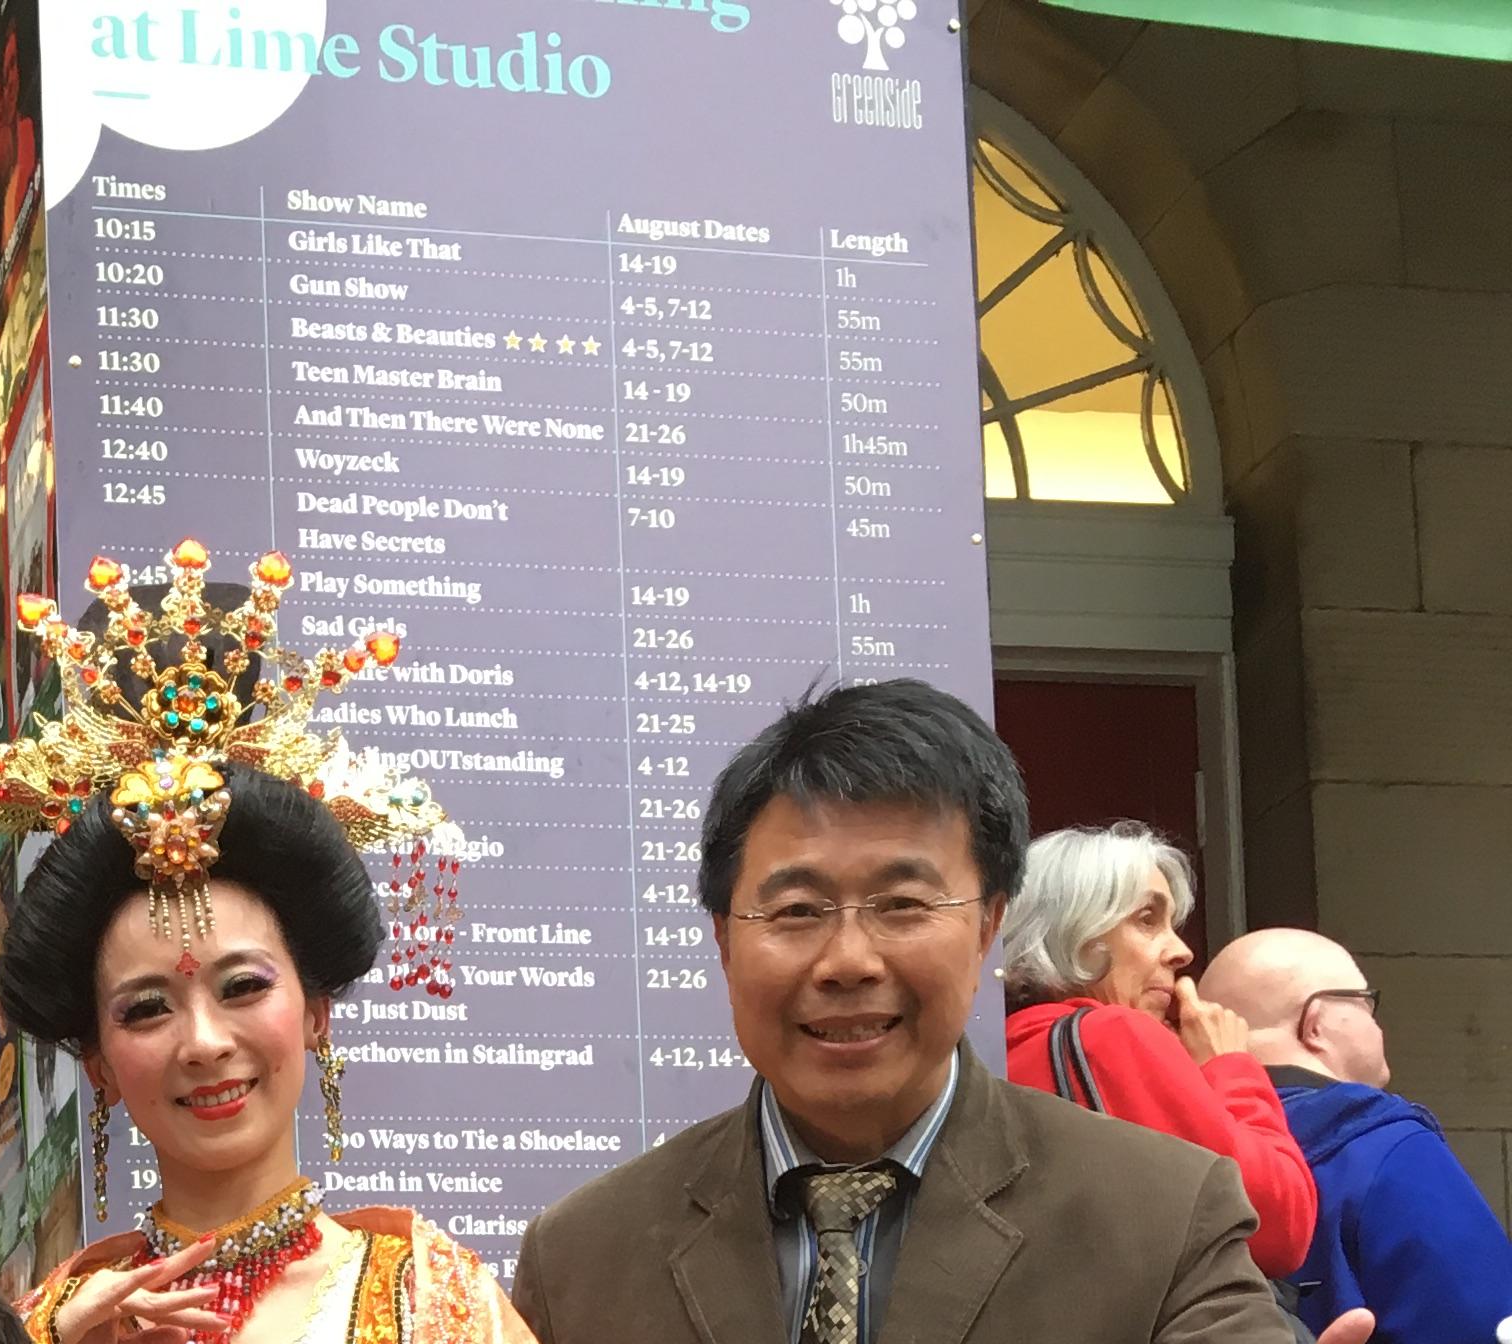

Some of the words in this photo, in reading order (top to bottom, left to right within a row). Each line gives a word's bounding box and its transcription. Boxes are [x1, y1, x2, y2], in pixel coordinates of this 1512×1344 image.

[91, 12, 160, 62] at
[178, 6, 361, 80] Lime
[378, 22, 612, 99] Studio
[92, 174, 166, 202] Times
[287, 188, 353, 214] Show
[357, 194, 429, 220] Name
[93, 216, 157, 242] 10:15
[617, 212, 701, 242] August
[704, 219, 771, 244] Dates
[287, 229, 349, 255] Girls
[352, 232, 403, 259] Like
[406, 236, 463, 262] That
[830, 228, 909, 257] Length
[94, 261, 165, 286] 10:20
[618, 252, 677, 276] 14-19
[289, 273, 342, 298] Gun
[345, 275, 409, 302] Show
[835, 267, 857, 289] 1h
[96, 305, 160, 331] 11:30
[668, 298, 713, 321] 7-12
[836, 308, 882, 332] 55m
[290, 317, 368, 344] Beasts
[370, 320, 393, 345] &
[395, 321, 497, 351] Beauties
[97, 350, 162, 375] 11:30
[669, 340, 714, 364] 7-12
[838, 350, 884, 373] 55m
[291, 360, 350, 386] Teen
[352, 363, 435, 392] Master
[437, 366, 503, 394] Brain
[98, 393, 165, 419] 11:40
[840, 392, 889, 415] 50m
[293, 403, 343, 429] And
[345, 406, 407, 432] Then
[409, 408, 479, 436] There
[481, 413, 542, 439] Were
[544, 416, 606, 443] None
[624, 423, 687, 446] 21-26
[100, 437, 169, 463] 12:40
[841, 433, 909, 457] 1h45m
[294, 446, 400, 478] Woyzeck
[625, 464, 686, 487] 14-19
[843, 476, 892, 498] 50m
[102, 481, 167, 507] 12:45
[296, 491, 358, 517] Dead
[361, 493, 441, 525] People
[627, 507, 676, 530] 7-10
[845, 517, 891, 540] 45m
[298, 527, 357, 553] Have
[359, 530, 446, 556] Secrets
[299, 571, 351, 599] Play
[353, 574, 482, 605] Something
[630, 585, 690, 608] 14-19
[849, 593, 871, 615] 1h
[301, 614, 345, 637] Sad
[347, 616, 408, 639] Girls
[632, 627, 695, 650] 21-26
[850, 635, 896, 657] 55m
[391, 660, 446, 684] with
[448, 663, 515, 688] Doris
[633, 671, 689, 697] 4-12,
[692, 672, 752, 695] 14-19
[384, 703, 442, 728] Who
[444, 705, 519, 730] Lunch
[636, 712, 697, 735] 21-25
[639, 798, 701, 820] 21-26
[640, 840, 702, 862] 21-26
[641, 883, 698, 908] 4-12,
[470, 922, 539, 945] Front
[541, 922, 593, 947] Line
[643, 925, 704, 948] 14-19
[459, 964, 518, 987] Your
[519, 966, 596, 990] Words
[645, 968, 708, 991] 21-26
[361, 999, 411, 1025] Just
[411, 1000, 469, 1022] Dust
[444, 1042, 470, 1065] in
[472, 1043, 594, 1072] Stalingrad
[649, 1047, 704, 1071] 4-12,
[368, 1128, 430, 1155] Ways
[432, 1130, 459, 1151] to
[460, 1130, 500, 1152] Tie
[502, 1134, 517, 1152] a
[519, 1130, 622, 1153] Shoelace
[324, 1170, 395, 1193] Death
[398, 1170, 424, 1193] in
[425, 1172, 504, 1195] Venice
